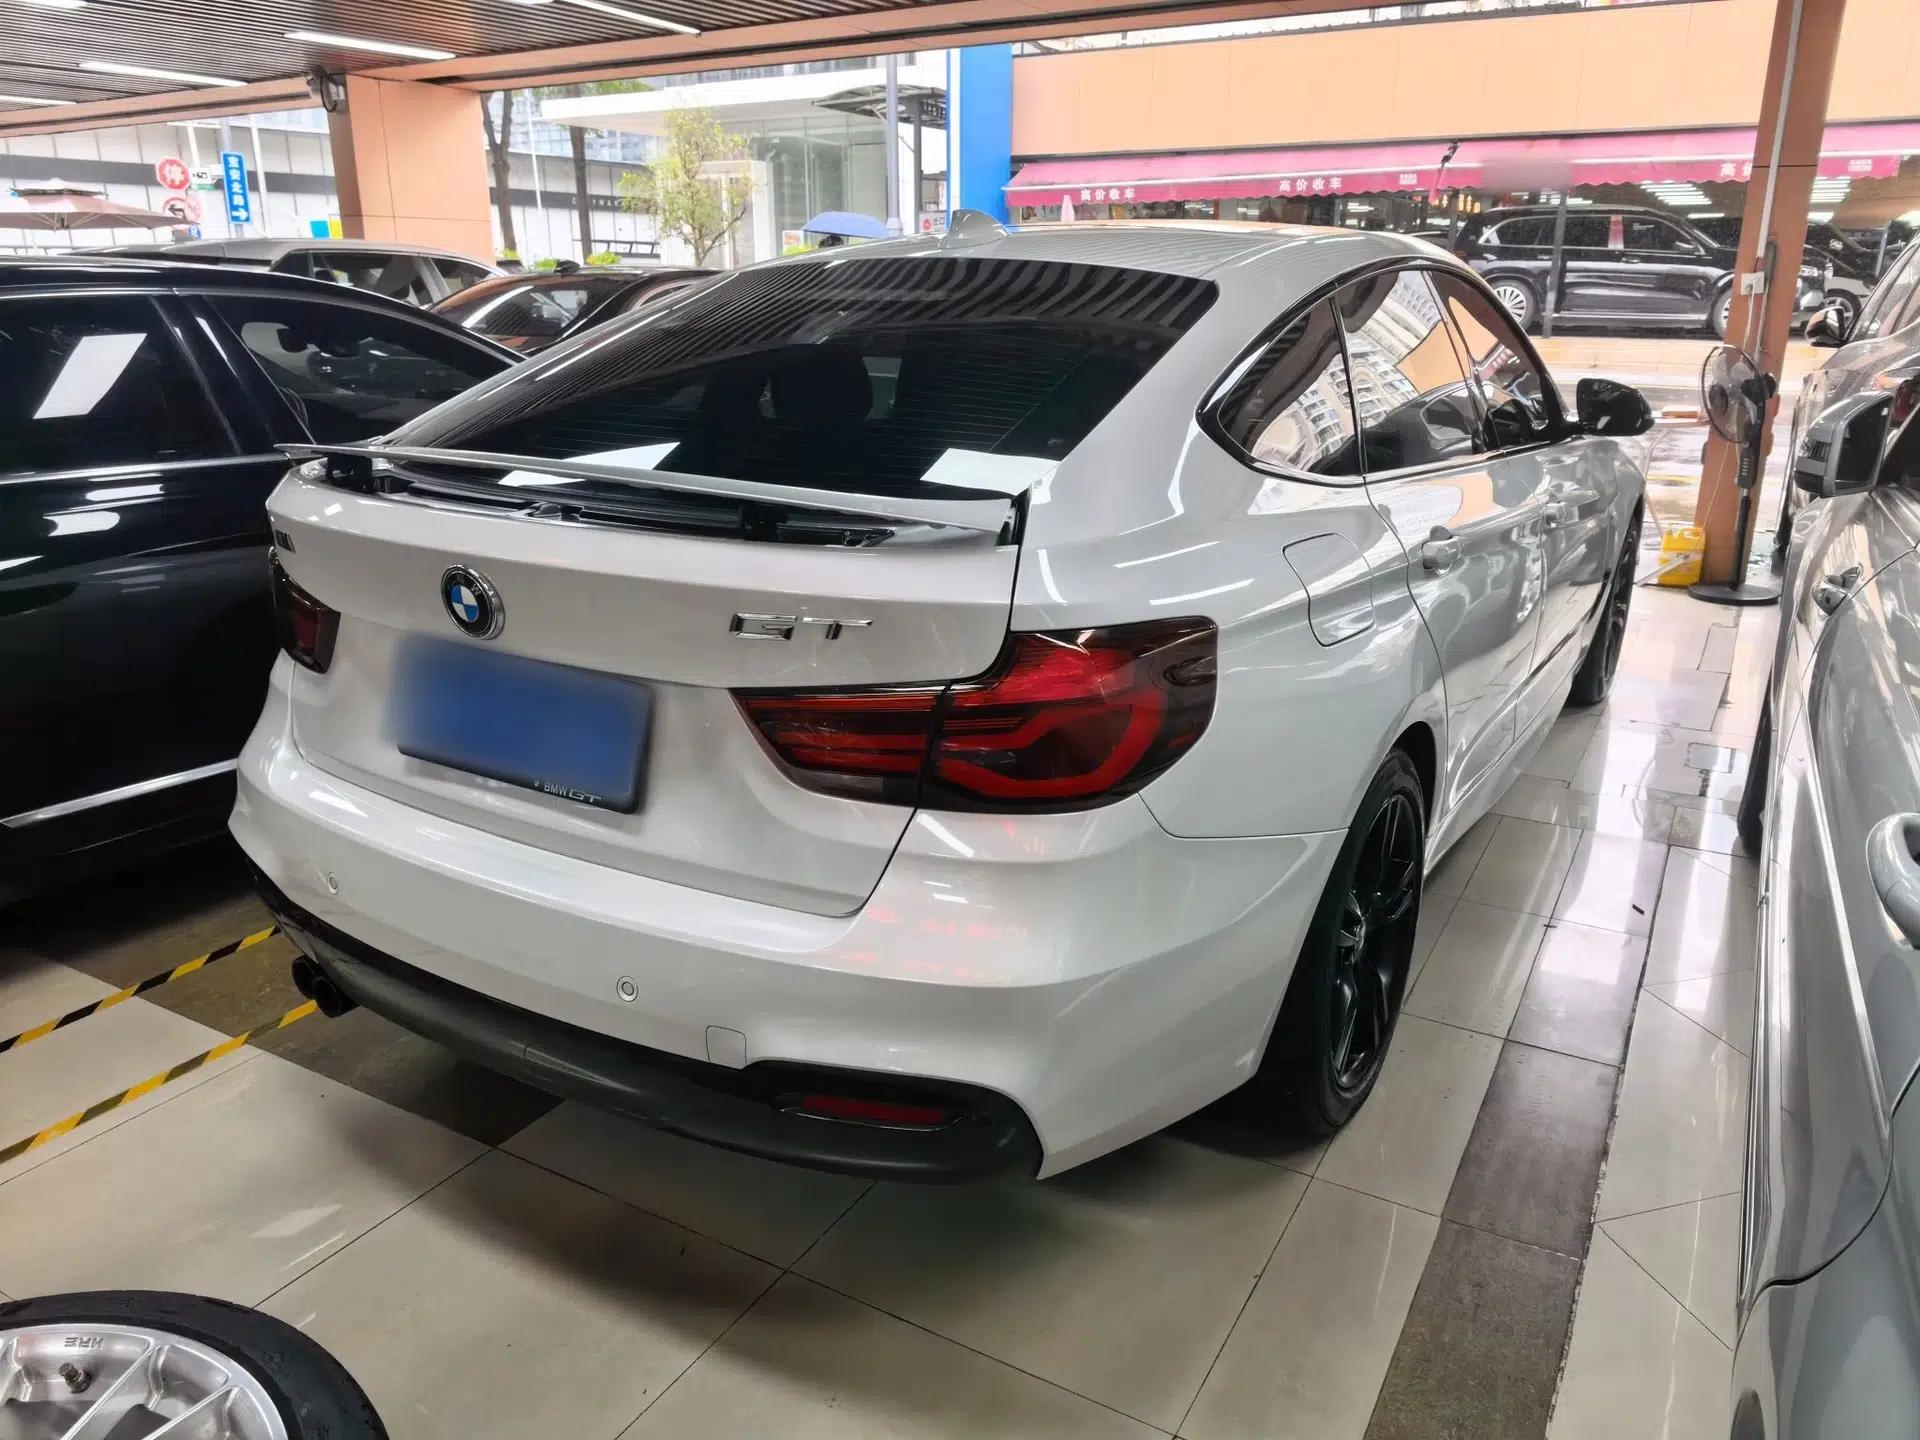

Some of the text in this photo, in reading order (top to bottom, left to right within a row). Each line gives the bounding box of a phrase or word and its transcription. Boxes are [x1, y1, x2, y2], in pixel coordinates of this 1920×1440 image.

[1279, 177, 1342, 192] 高价收车
[1080, 187, 1136, 201] 高价收车
[729, 612, 873, 640] GT
[543, 781, 602, 802] BMW GT
